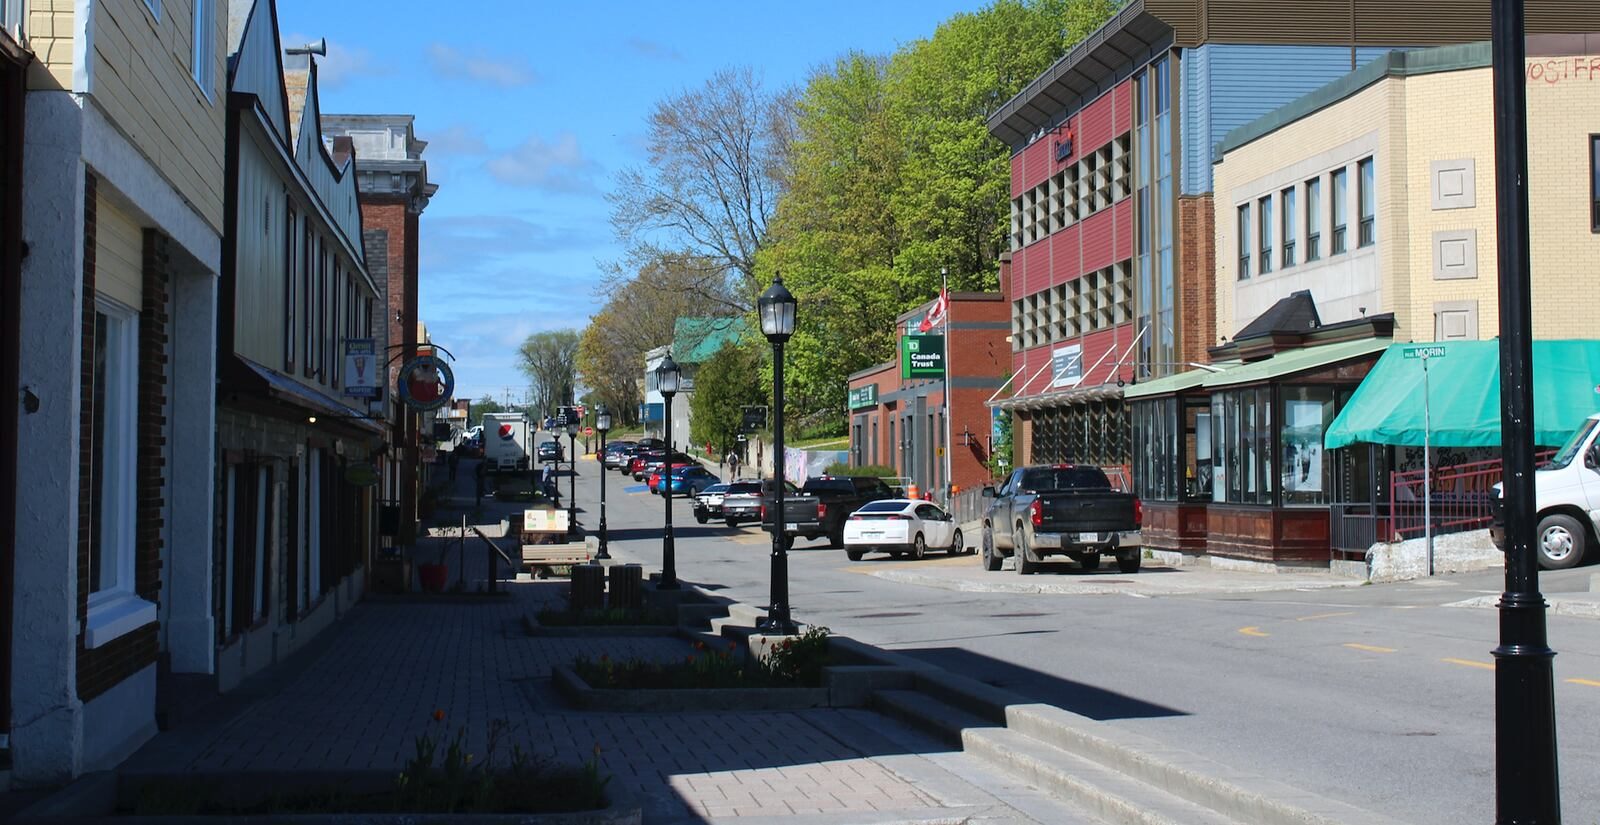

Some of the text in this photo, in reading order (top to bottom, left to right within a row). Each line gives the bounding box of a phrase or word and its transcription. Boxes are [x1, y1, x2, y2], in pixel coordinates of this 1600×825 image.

[907, 341, 918, 350] TD
[1415, 347, 1444, 357] MORIN
[911, 360, 934, 368] Trust
